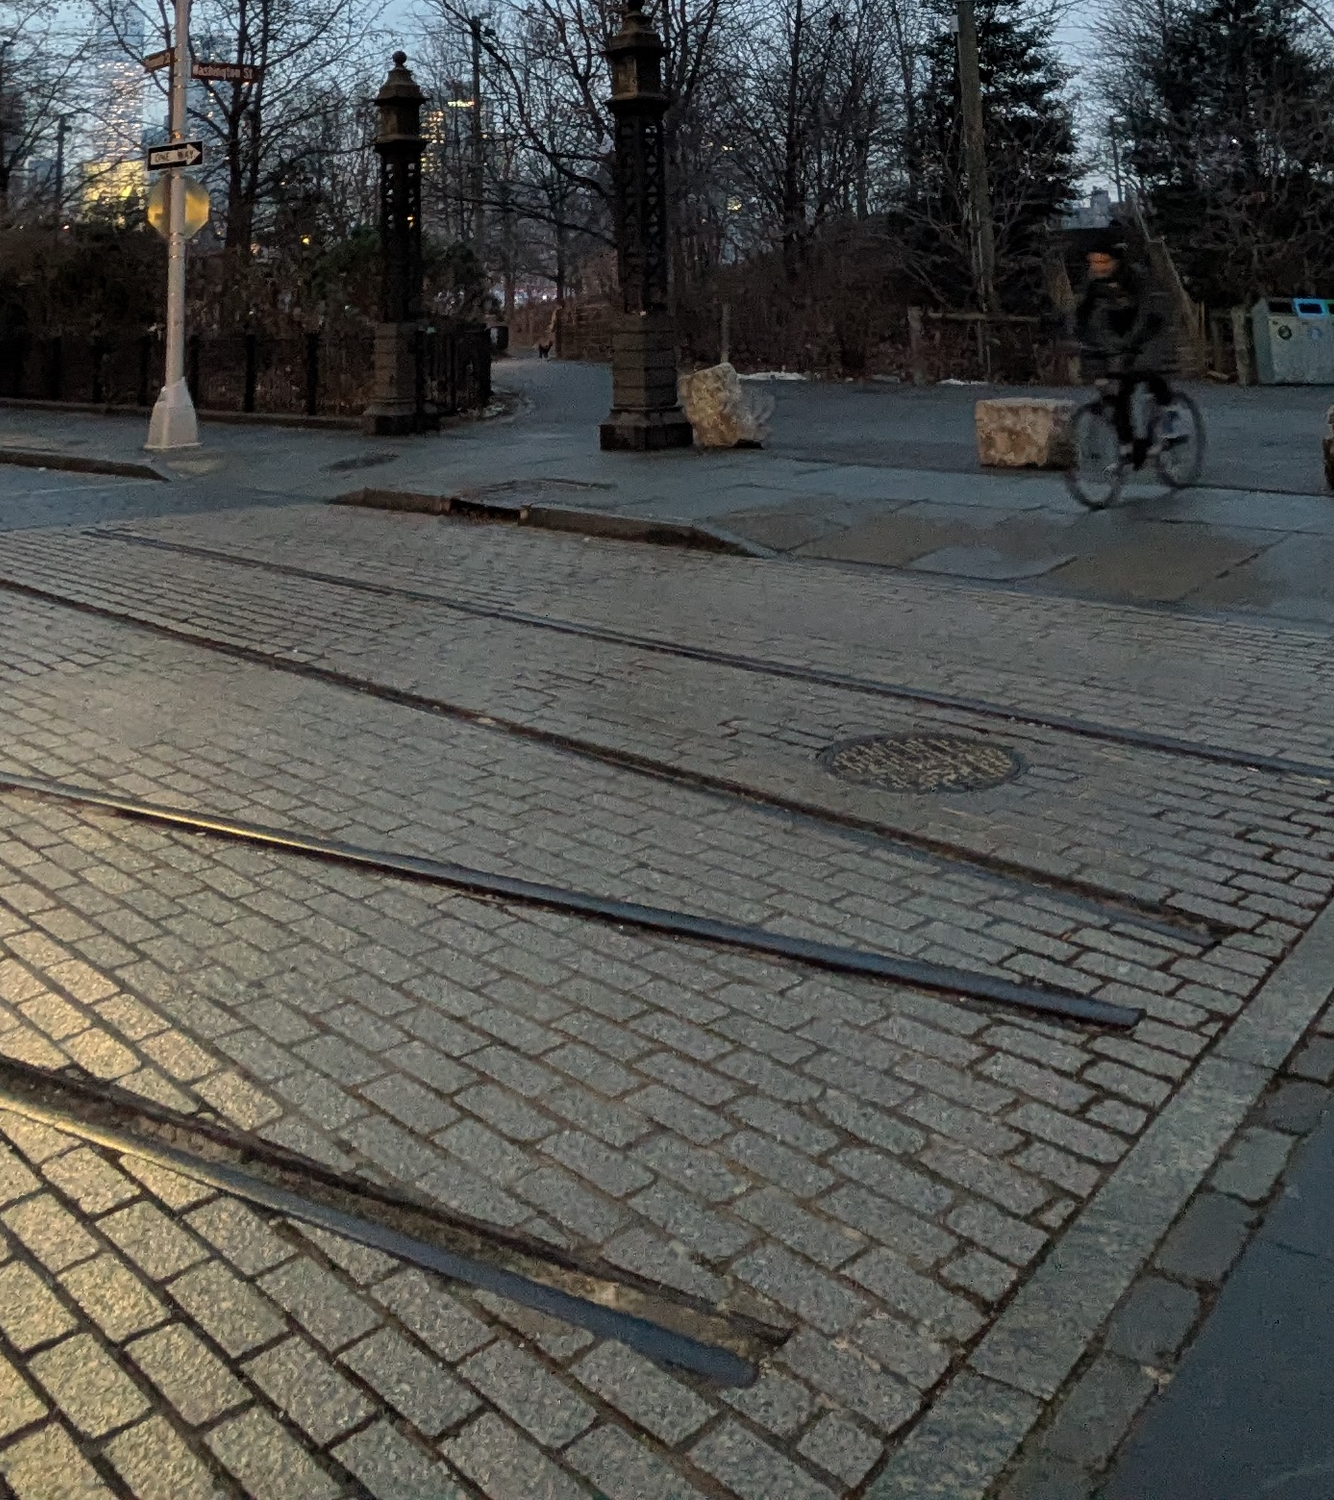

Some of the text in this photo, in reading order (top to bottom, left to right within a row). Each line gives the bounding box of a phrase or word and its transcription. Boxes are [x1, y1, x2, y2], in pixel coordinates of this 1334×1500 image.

[192, 63, 241, 80] Washington
[154, 150, 194, 163] ONE WAY
